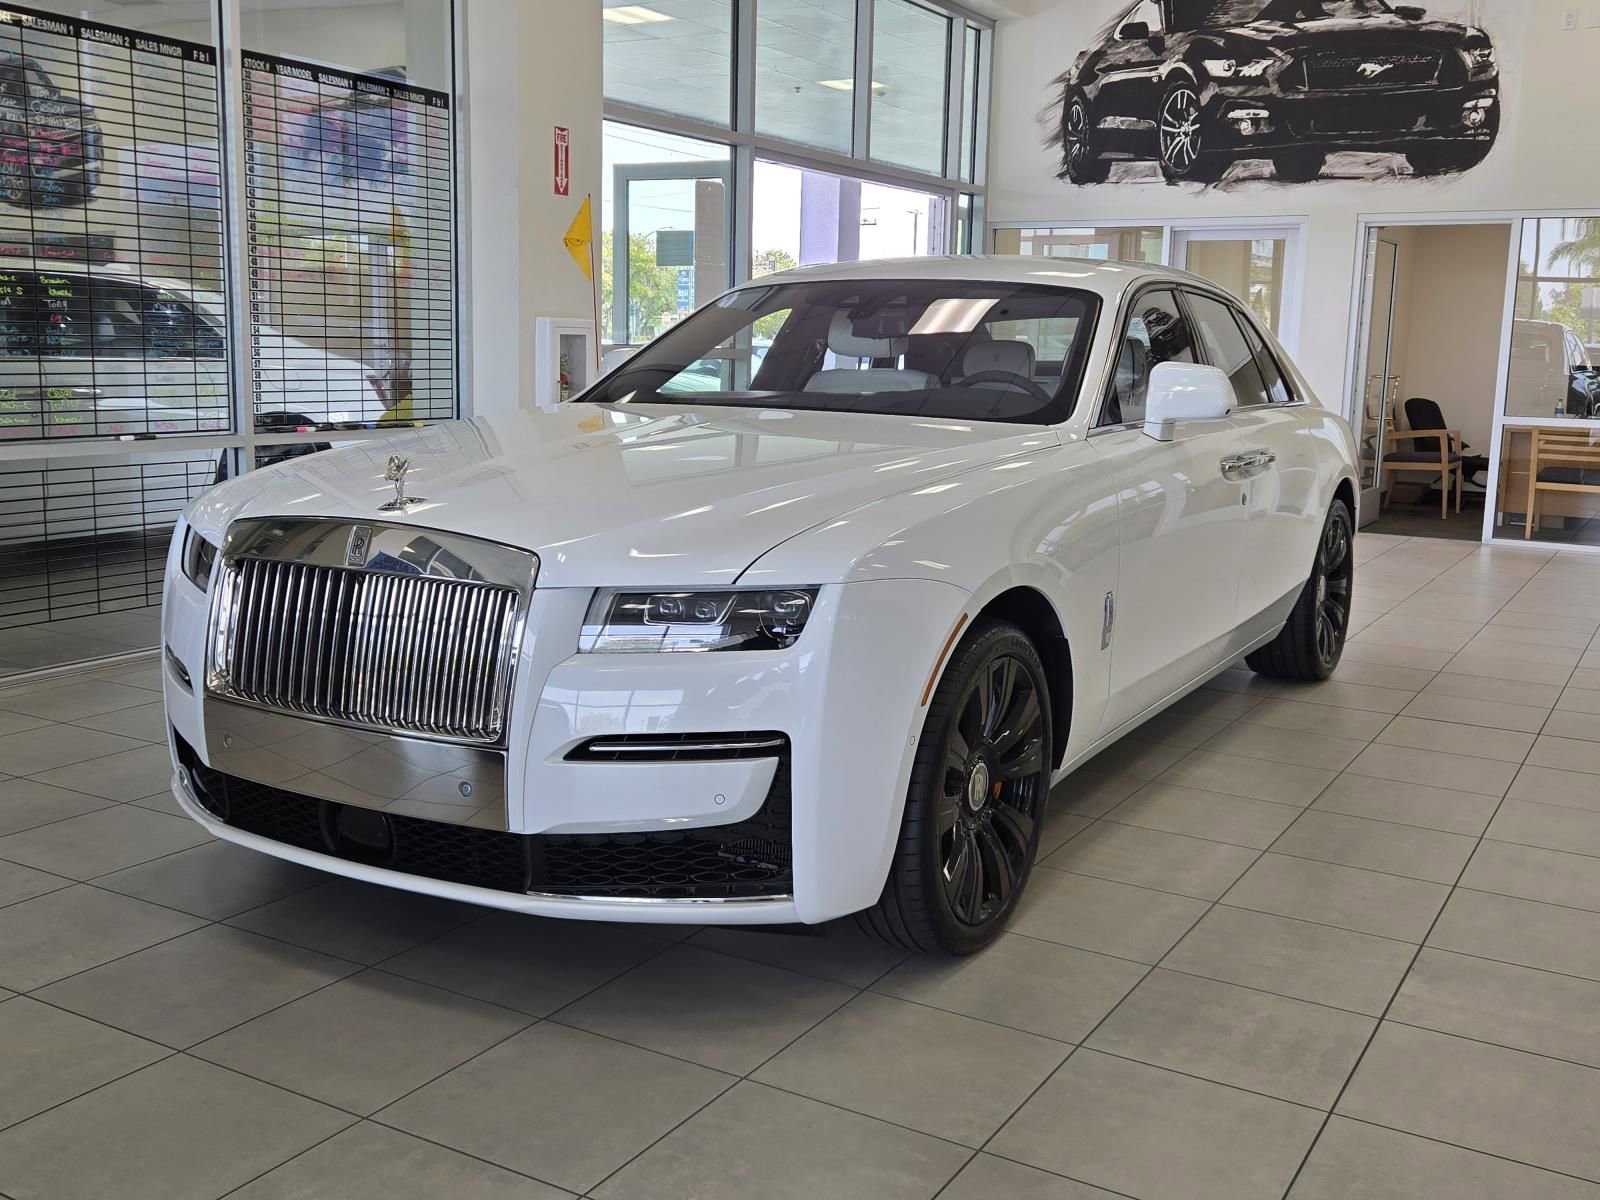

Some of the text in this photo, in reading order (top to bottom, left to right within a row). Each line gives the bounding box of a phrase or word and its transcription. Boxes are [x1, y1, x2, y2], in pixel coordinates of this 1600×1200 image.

[22, 15, 67, 35] SALESMAN
[69, 25, 74, 36] 1
[80, 27, 125, 46] SALESMAN
[124, 36, 130, 48] 2
[135, 38, 159, 53] SALES
[159, 43, 182, 57] MNGR
[193, 50, 198, 61] F
[206, 52, 209, 63] I
[243, 57, 265, 71] STOCK
[318, 72, 349, 88] SALESMAN
[349, 79, 353, 89] 1
[356, 81, 385, 96] SALESMAN
[385, 87, 391, 96] 2
[393, 88, 409, 100] SALES
[432, 97, 437, 106] F
